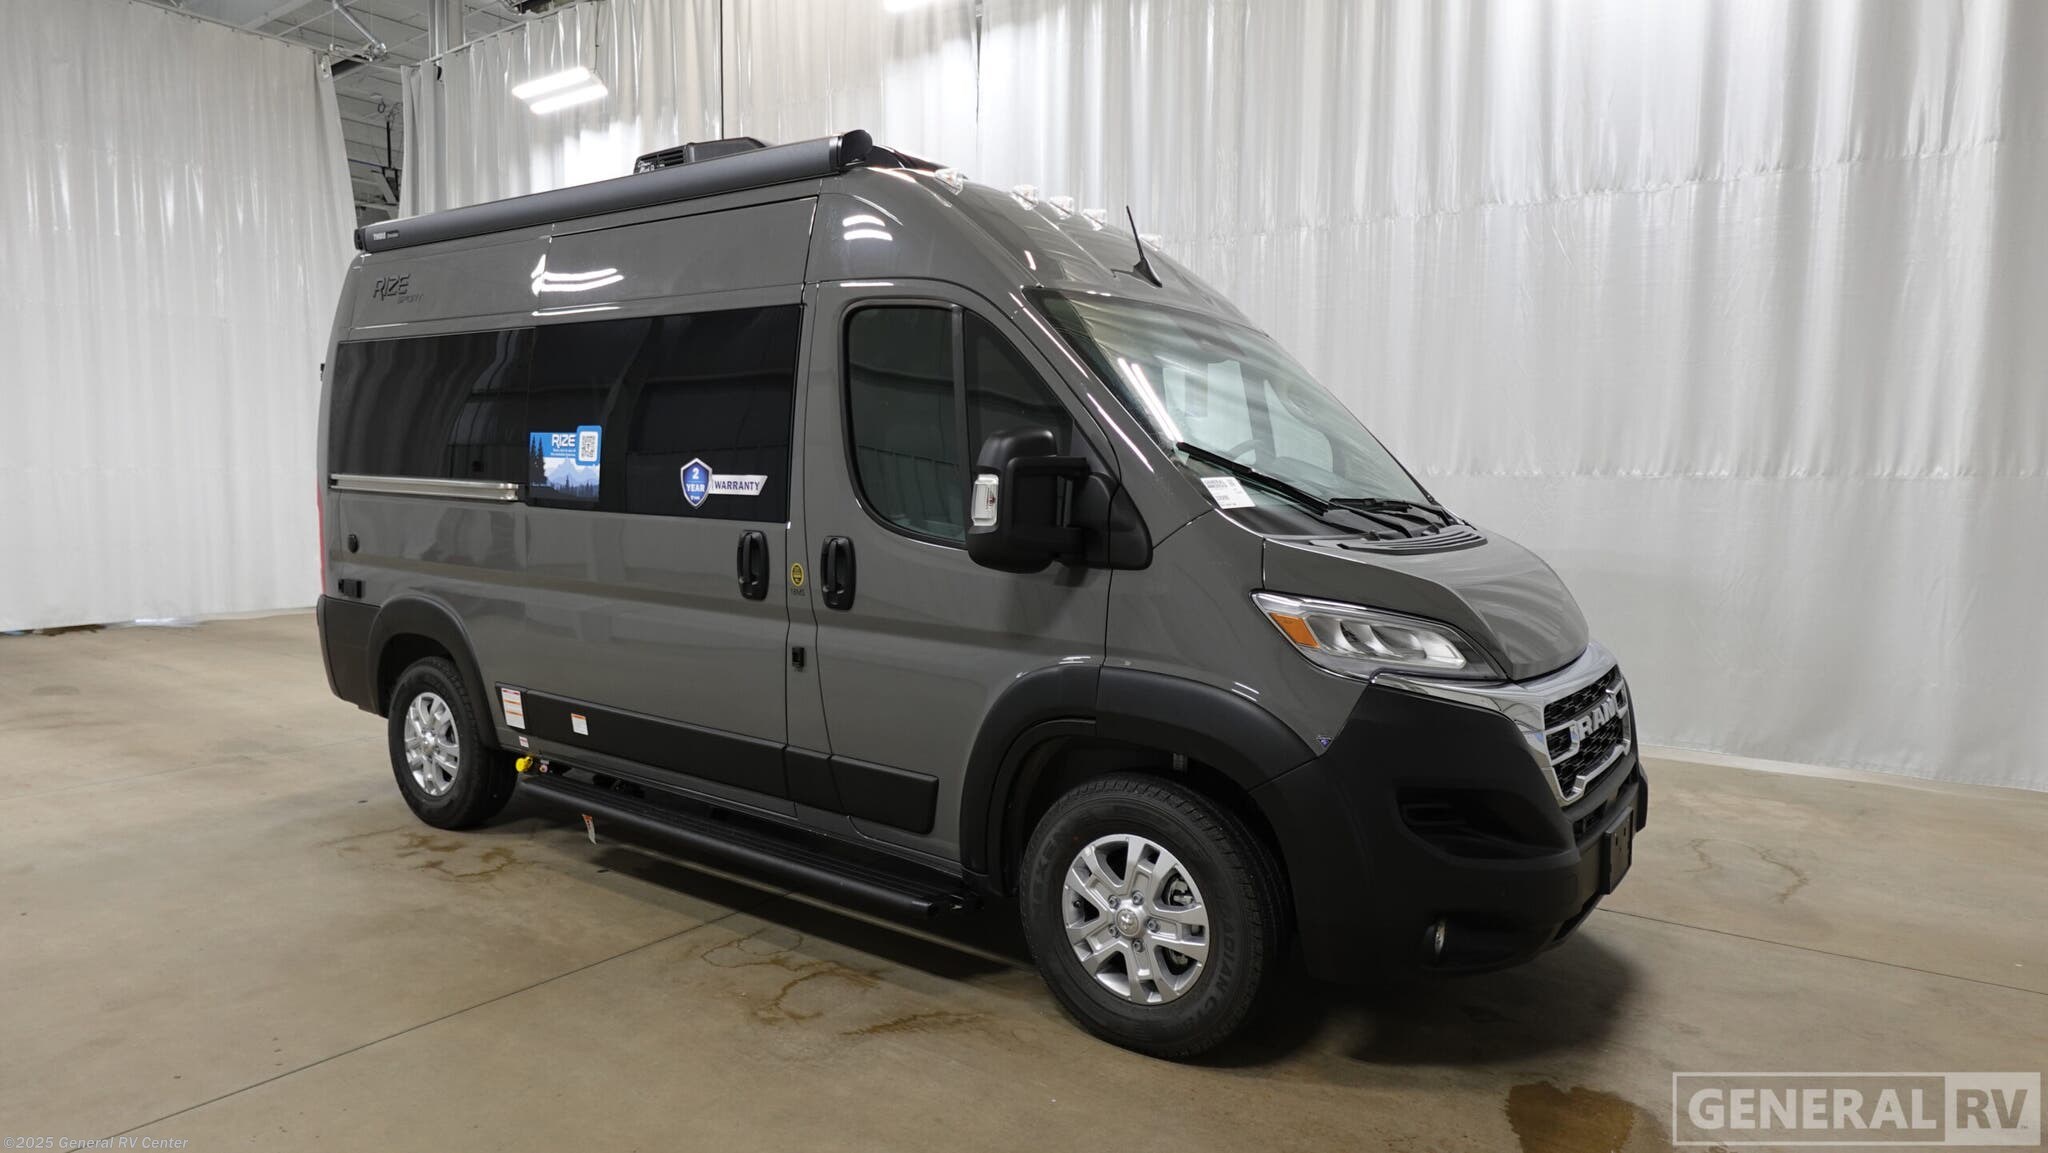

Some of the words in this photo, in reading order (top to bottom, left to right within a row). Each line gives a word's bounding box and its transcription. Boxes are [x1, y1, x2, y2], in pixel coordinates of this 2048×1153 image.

[372, 273, 412, 301] RIZE
[551, 433, 577, 448] RIZE
[692, 467, 700, 480] 2
[686, 483, 706, 492] YEAR
[714, 480, 760, 491] WARRANTY
[1577, 696, 1617, 741] RAM
